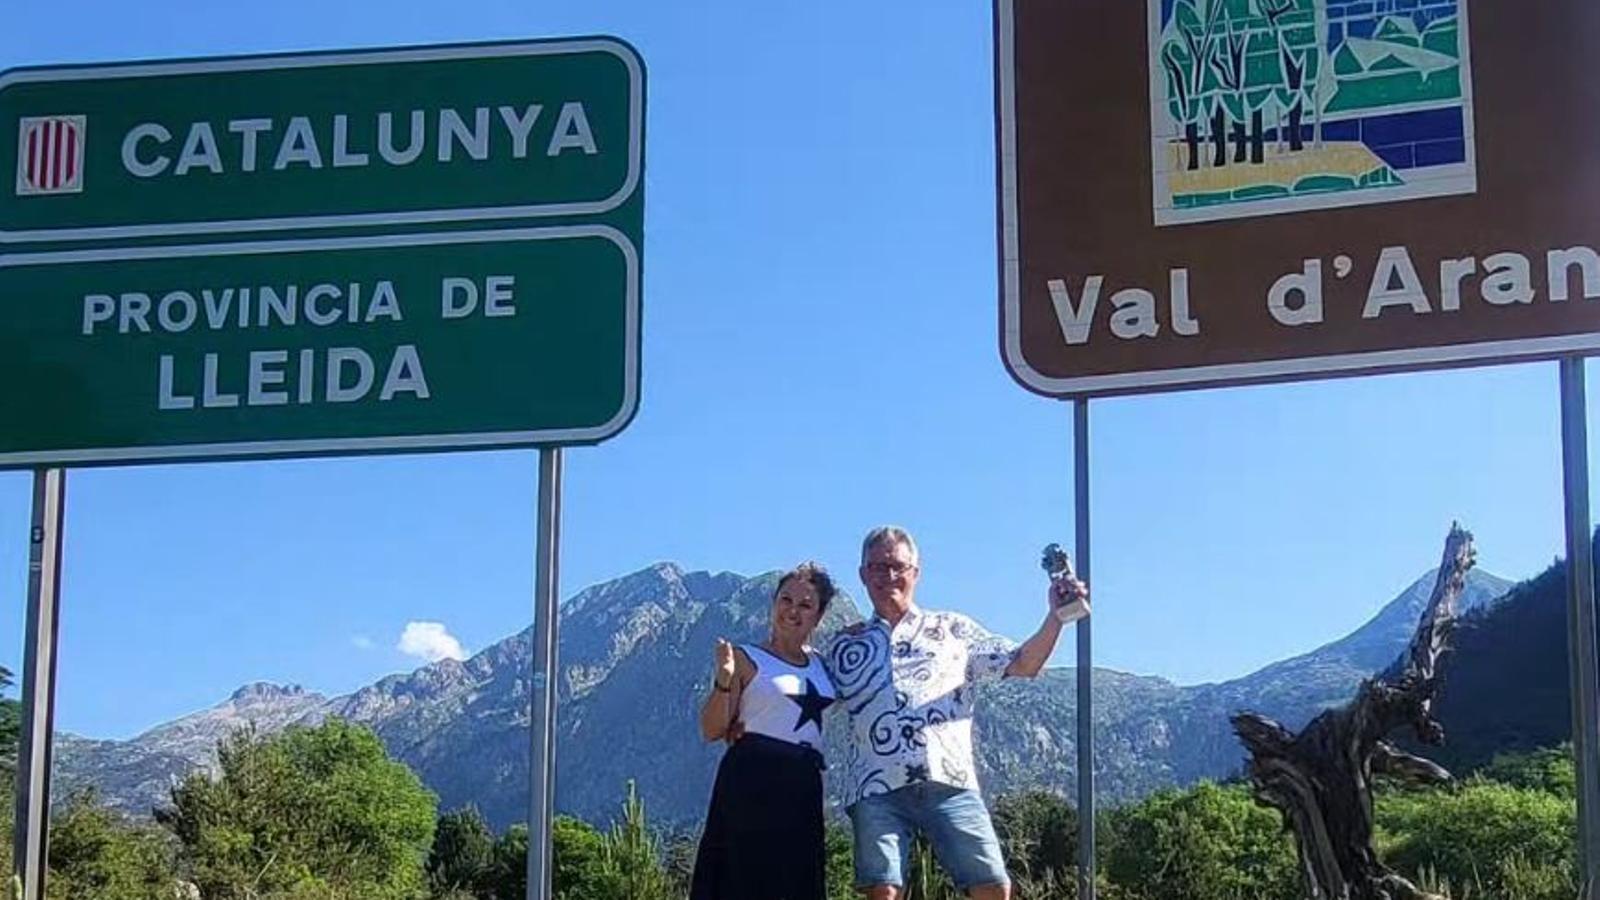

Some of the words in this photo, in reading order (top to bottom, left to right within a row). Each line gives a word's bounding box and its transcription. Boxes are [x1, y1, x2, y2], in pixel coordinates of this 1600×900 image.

[120, 101, 598, 178] CATALUNYA
[81, 281, 402, 335] PROVINCIA
[441, 275, 516, 318] DE
[1047, 268, 1199, 345] Val
[158, 344, 430, 410] LLEIDA
